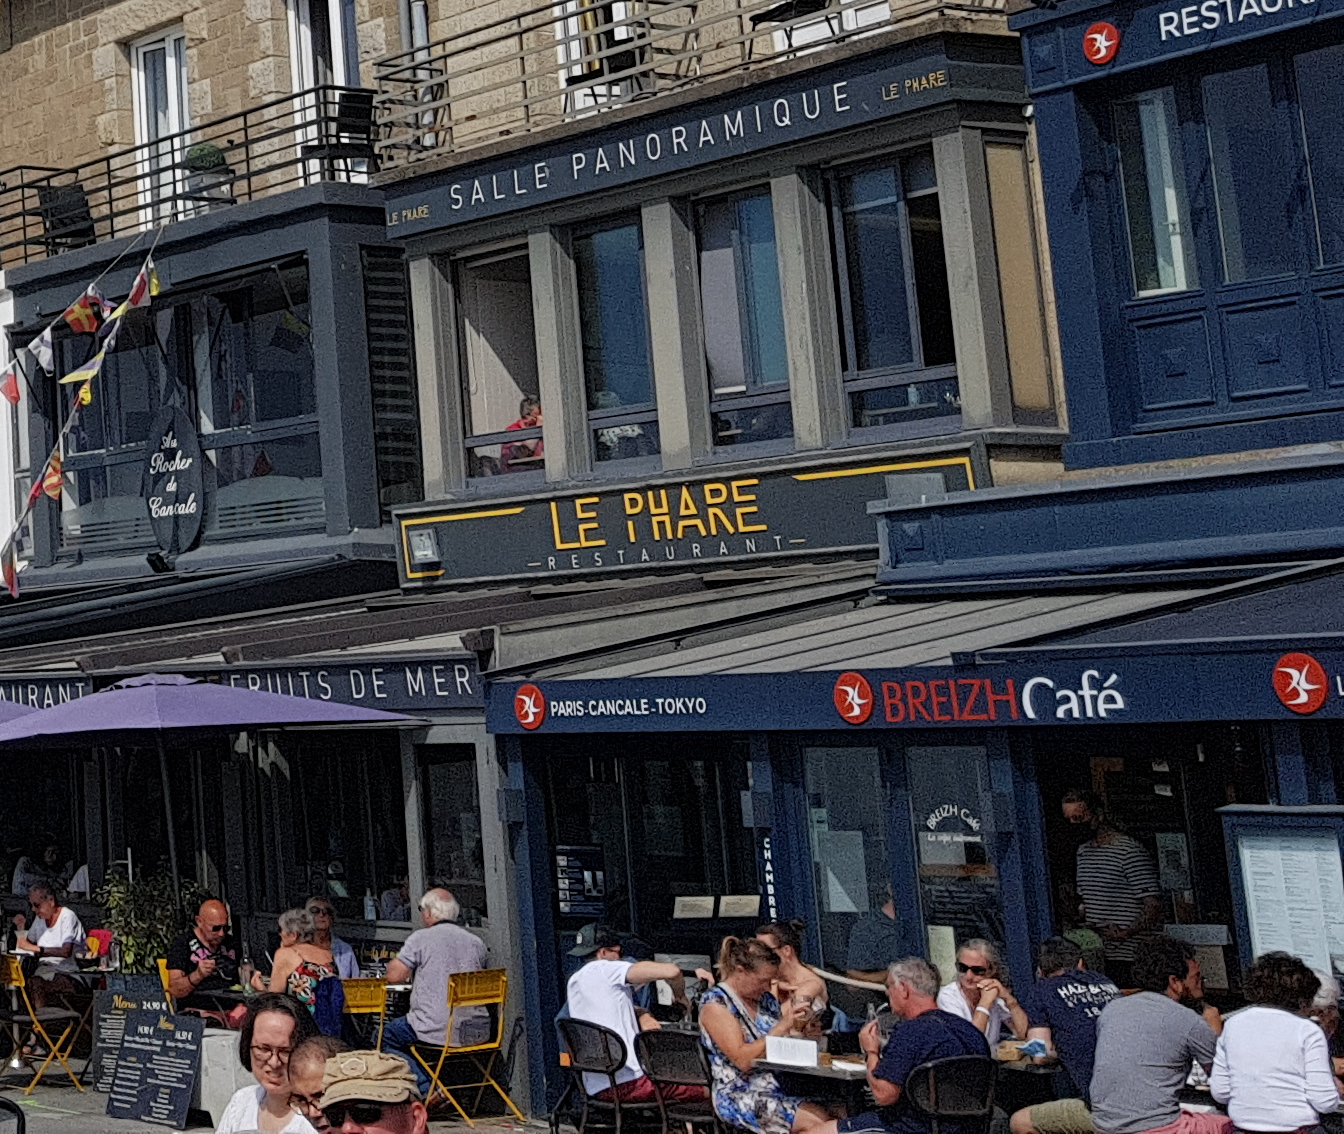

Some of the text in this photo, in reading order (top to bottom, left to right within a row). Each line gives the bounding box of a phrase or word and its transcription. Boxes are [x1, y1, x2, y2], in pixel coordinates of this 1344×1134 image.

[881, 70, 947, 101] LE PHARE
[450, 81, 851, 210] SALLE PANORAMIQUE
[387, 211, 399, 226] LE
[161, 430, 178, 449] Au
[149, 449, 193, 475] Rocher
[166, 475, 178, 492] de
[148, 492, 197, 518] Cancale
[550, 479, 768, 550] LE PHARE
[547, 535, 784, 570] RESTAURANT
[349, 667, 388, 699] DE
[404, 664, 473, 697] MER
[881, 669, 1125, 723] BREIZH Café
[926, 804, 981, 831] BREIZH Café
[763, 837, 778, 923] CHAMBRE
[112, 994, 138, 1009] Menu
